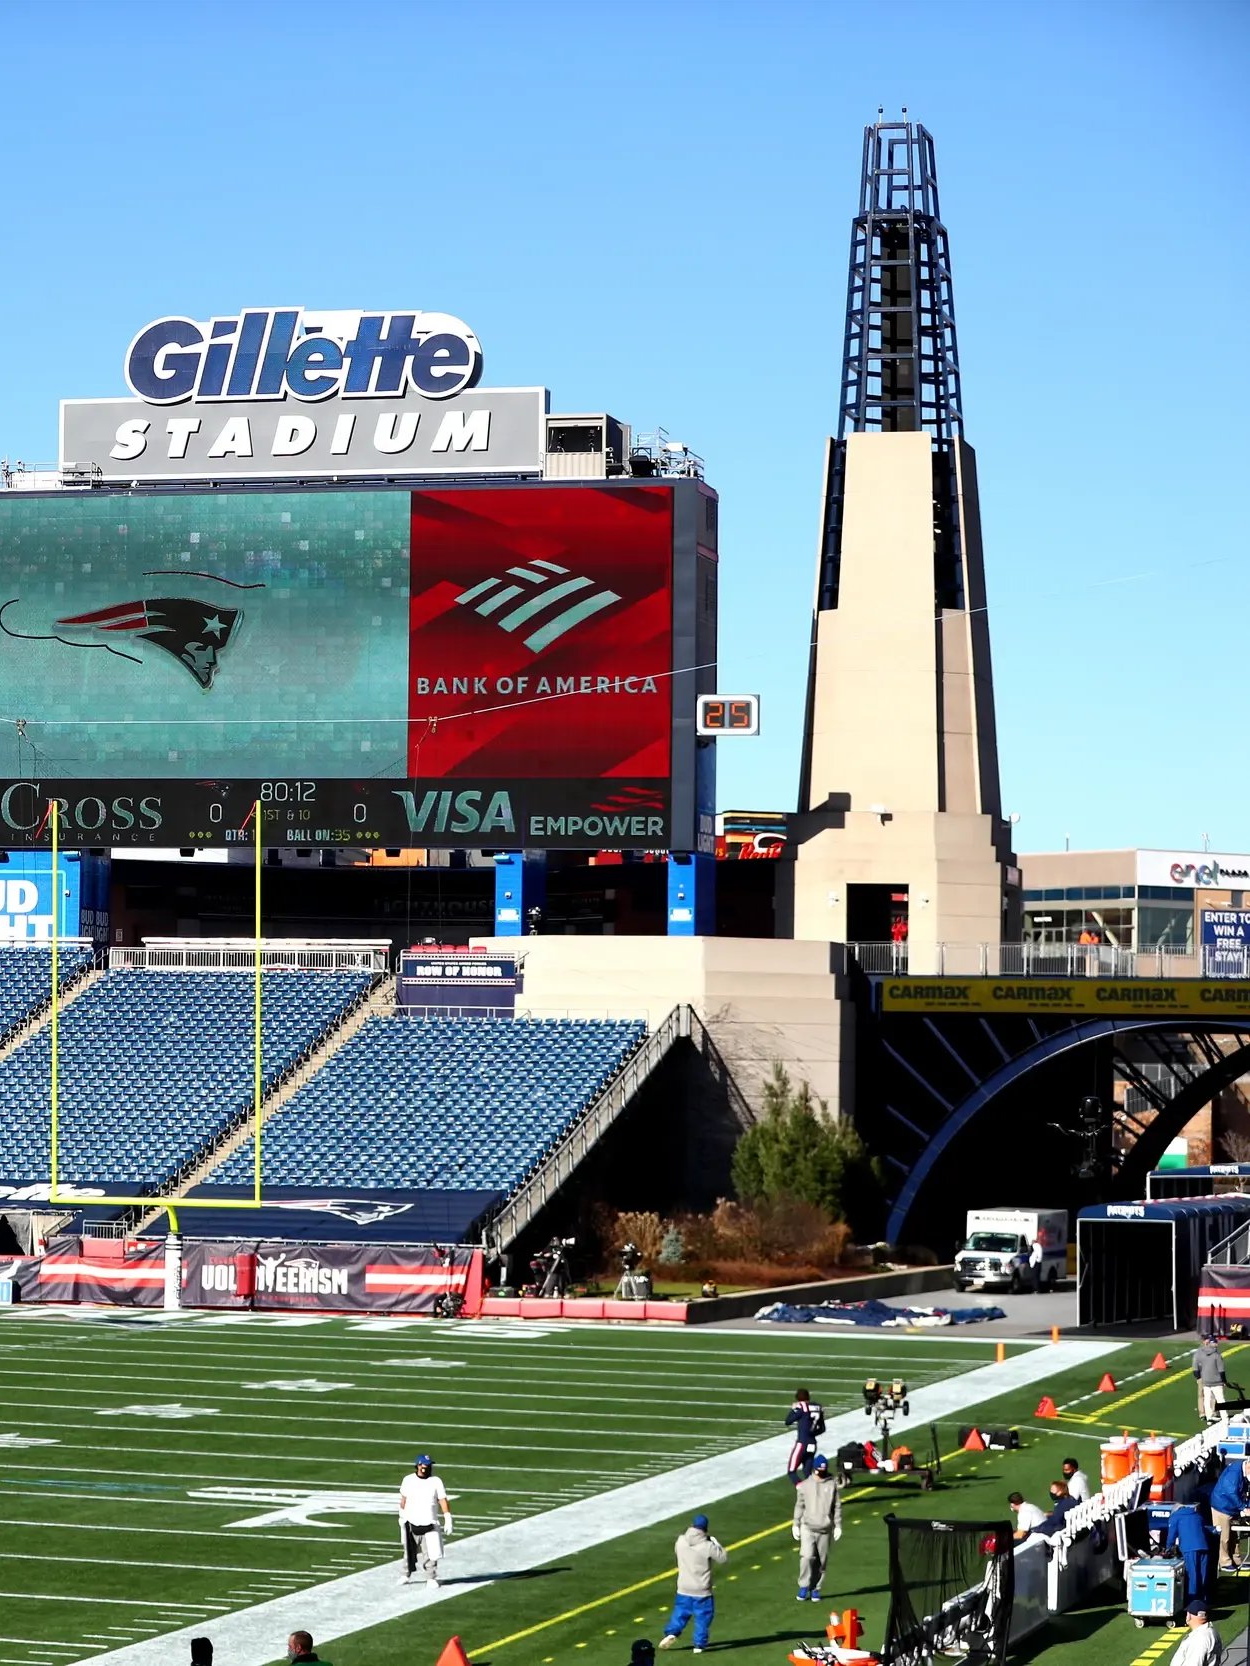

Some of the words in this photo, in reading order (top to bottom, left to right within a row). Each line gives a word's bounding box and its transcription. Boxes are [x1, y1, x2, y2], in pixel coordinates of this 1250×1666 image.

[125, 307, 484, 406] Gillette
[109, 410, 492, 462] STADIUM
[417, 677, 488, 695] BANK
[496, 676, 530, 694] OF
[536, 675, 658, 694] AMERICA
[706, 703, 749, 728] 25
[260, 782, 316, 802] 80:12
[210, 804, 222, 823] 0
[263, 809, 280, 821] 1ST
[354, 804, 367, 823] 0
[391, 790, 516, 833] VISA
[225, 829, 248, 841] QTR:
[286, 829, 312, 841] BALL
[529, 816, 664, 836] EMPOWER
[10, 832, 156, 842] INSURANCE
[1170, 860, 1219, 885] enel
[1205, 912, 1236, 922] ENTER
[1213, 926, 1234, 936] WIN
[1236, 926, 1245, 937] A
[1217, 938, 1242, 949] FREE
[416, 966, 442, 976] ROW
[445, 966, 460, 976] OF
[461, 966, 502, 976] HONOR
[1107, 1205, 1145, 1219] PATRIOTS
[202, 1253, 348, 1294] VOLNTEERISM
